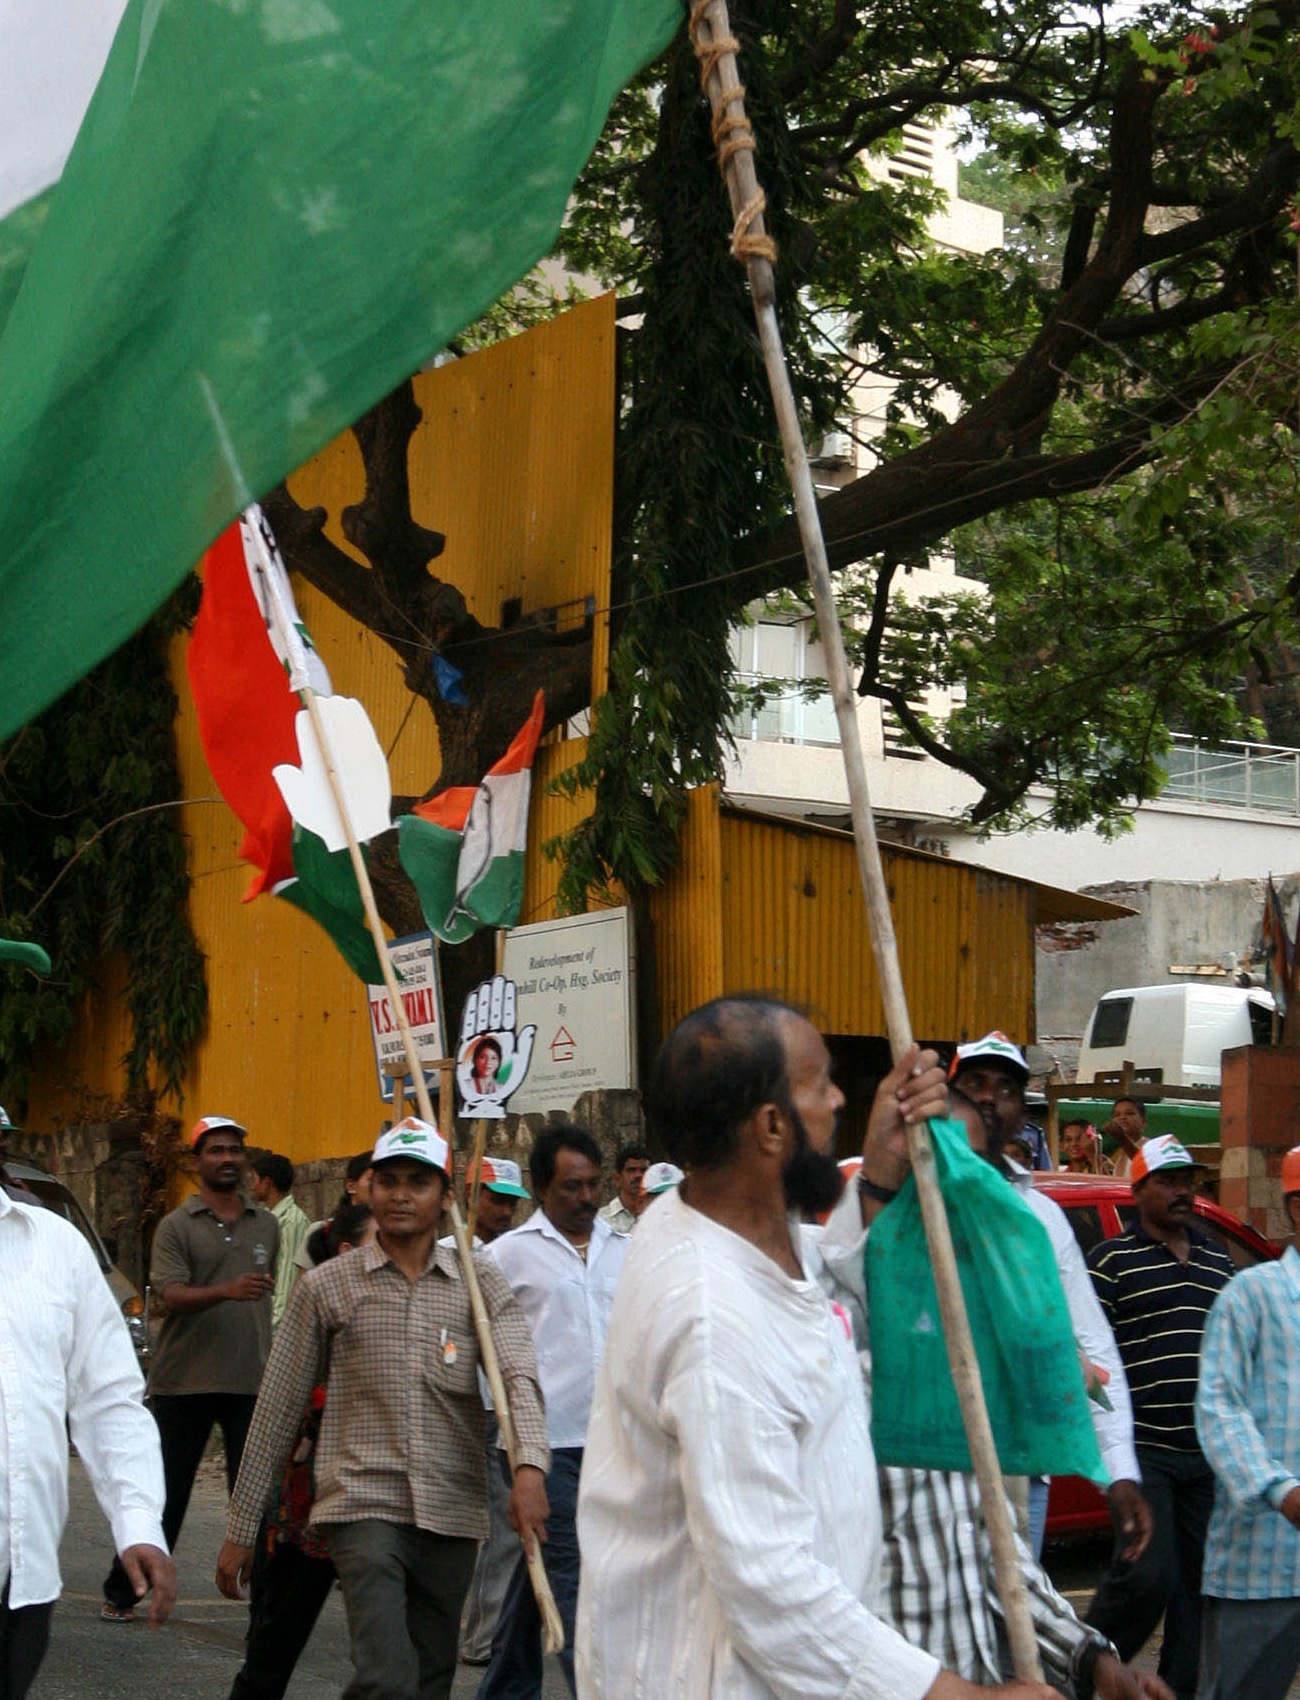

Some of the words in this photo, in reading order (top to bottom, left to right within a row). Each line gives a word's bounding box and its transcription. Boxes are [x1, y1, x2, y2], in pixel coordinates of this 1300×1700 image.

[529, 951, 584, 970] Redevelopment
[585, 947, 596, 964] of
[591, 967, 622, 985] Society
